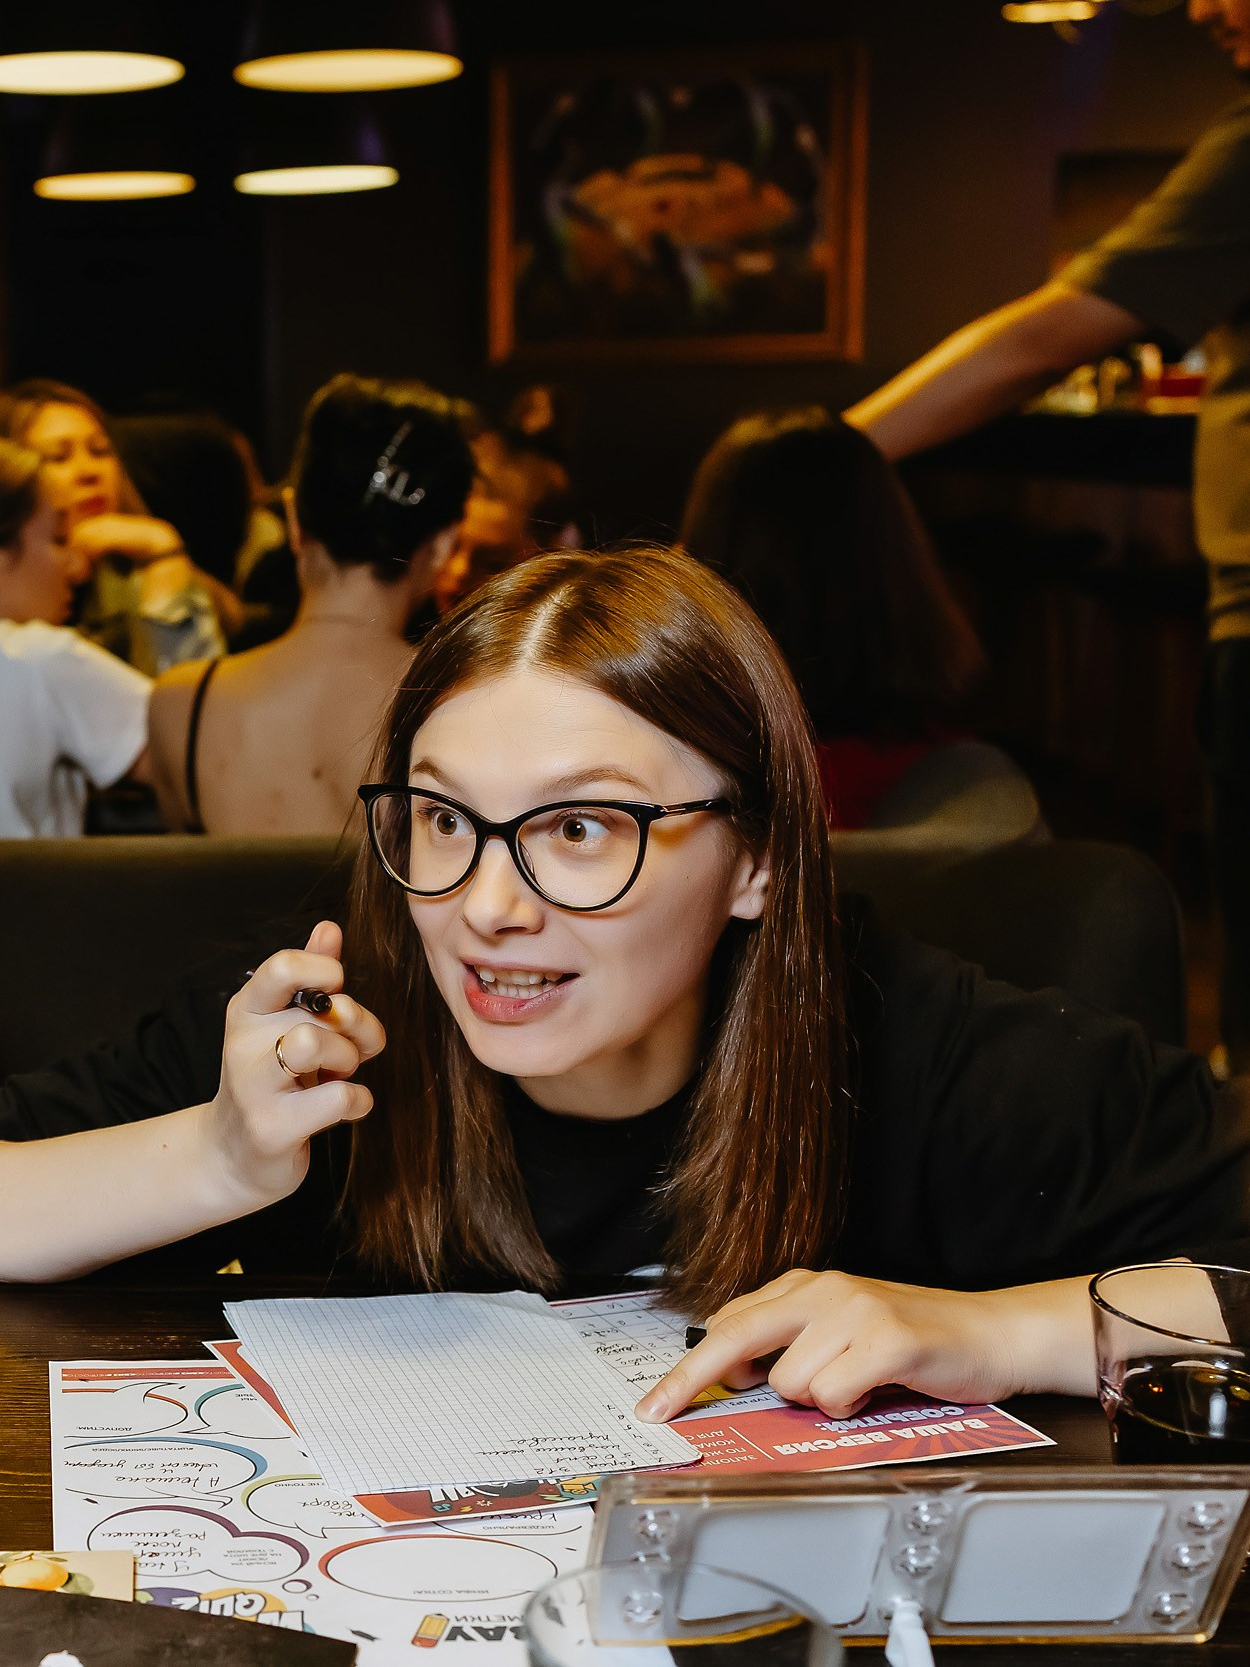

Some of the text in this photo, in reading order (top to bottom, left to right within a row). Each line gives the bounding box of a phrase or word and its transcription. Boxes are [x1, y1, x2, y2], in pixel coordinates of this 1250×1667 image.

[814, 1405, 966, 1433] СОБЫТИЙ:
[696, 1430, 724, 1439] ДЛЯ
[772, 1417, 990, 1456] ВАША ВЕРСИЯ
[702, 1450, 724, 1458] ЖЕ
[454, 1614, 524, 1624] МЕТКИ
